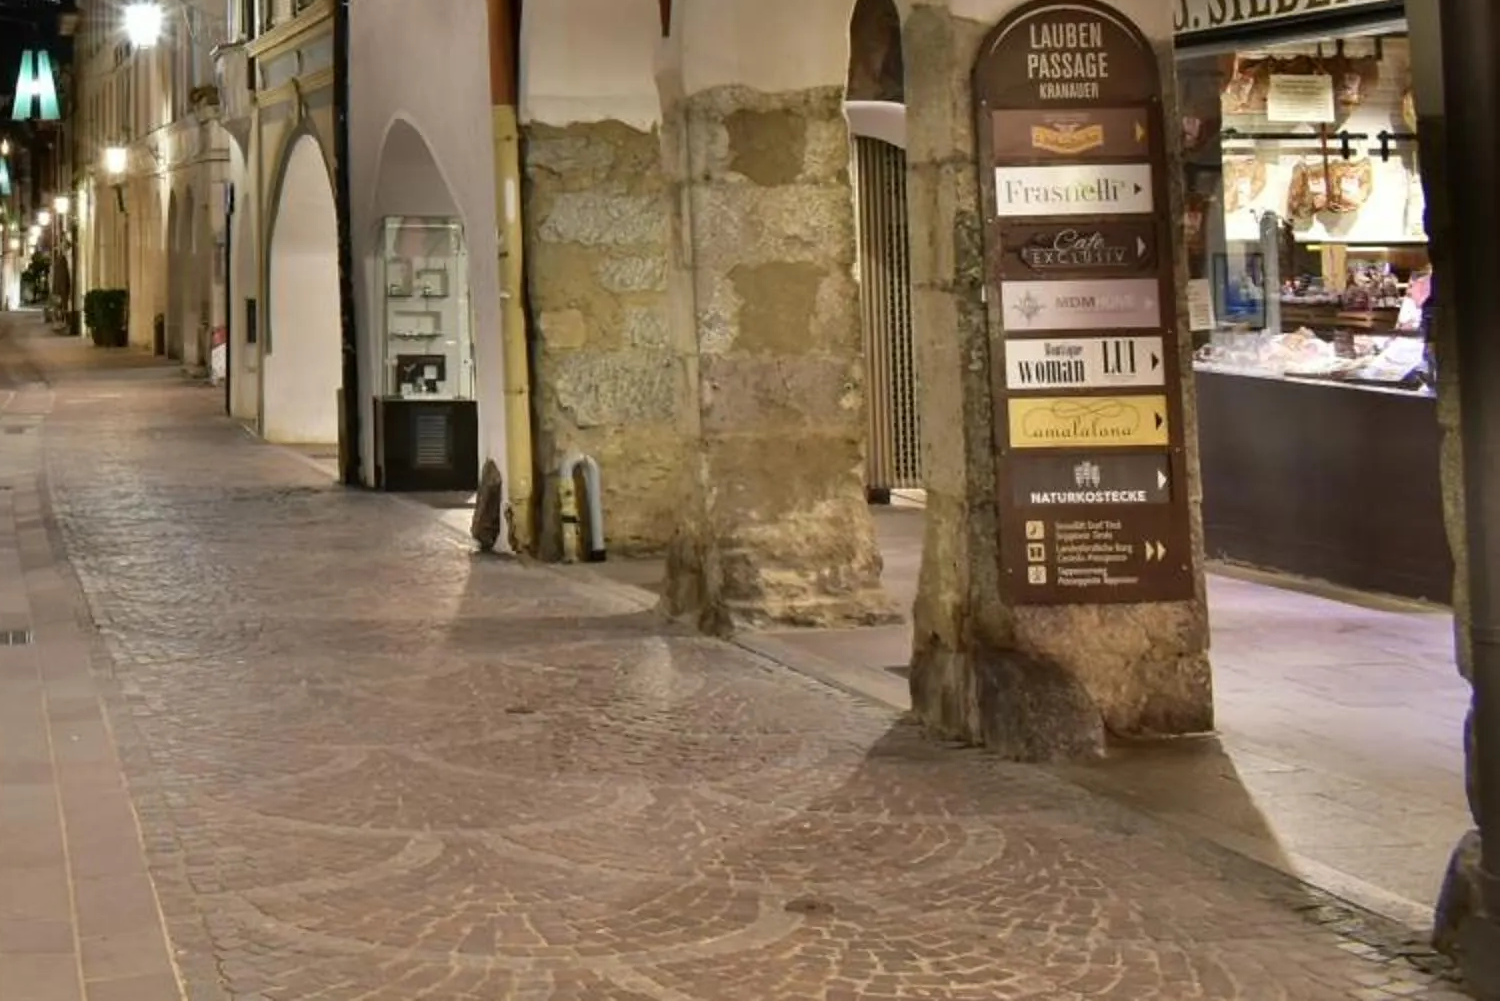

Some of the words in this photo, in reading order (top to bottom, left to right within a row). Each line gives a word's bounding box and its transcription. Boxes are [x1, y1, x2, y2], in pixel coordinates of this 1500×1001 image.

[1030, 22, 1102, 49] LAUBEN
[1027, 52, 1109, 79] PASSAGE
[1030, 490, 1148, 505] NATURKOSTECKE
